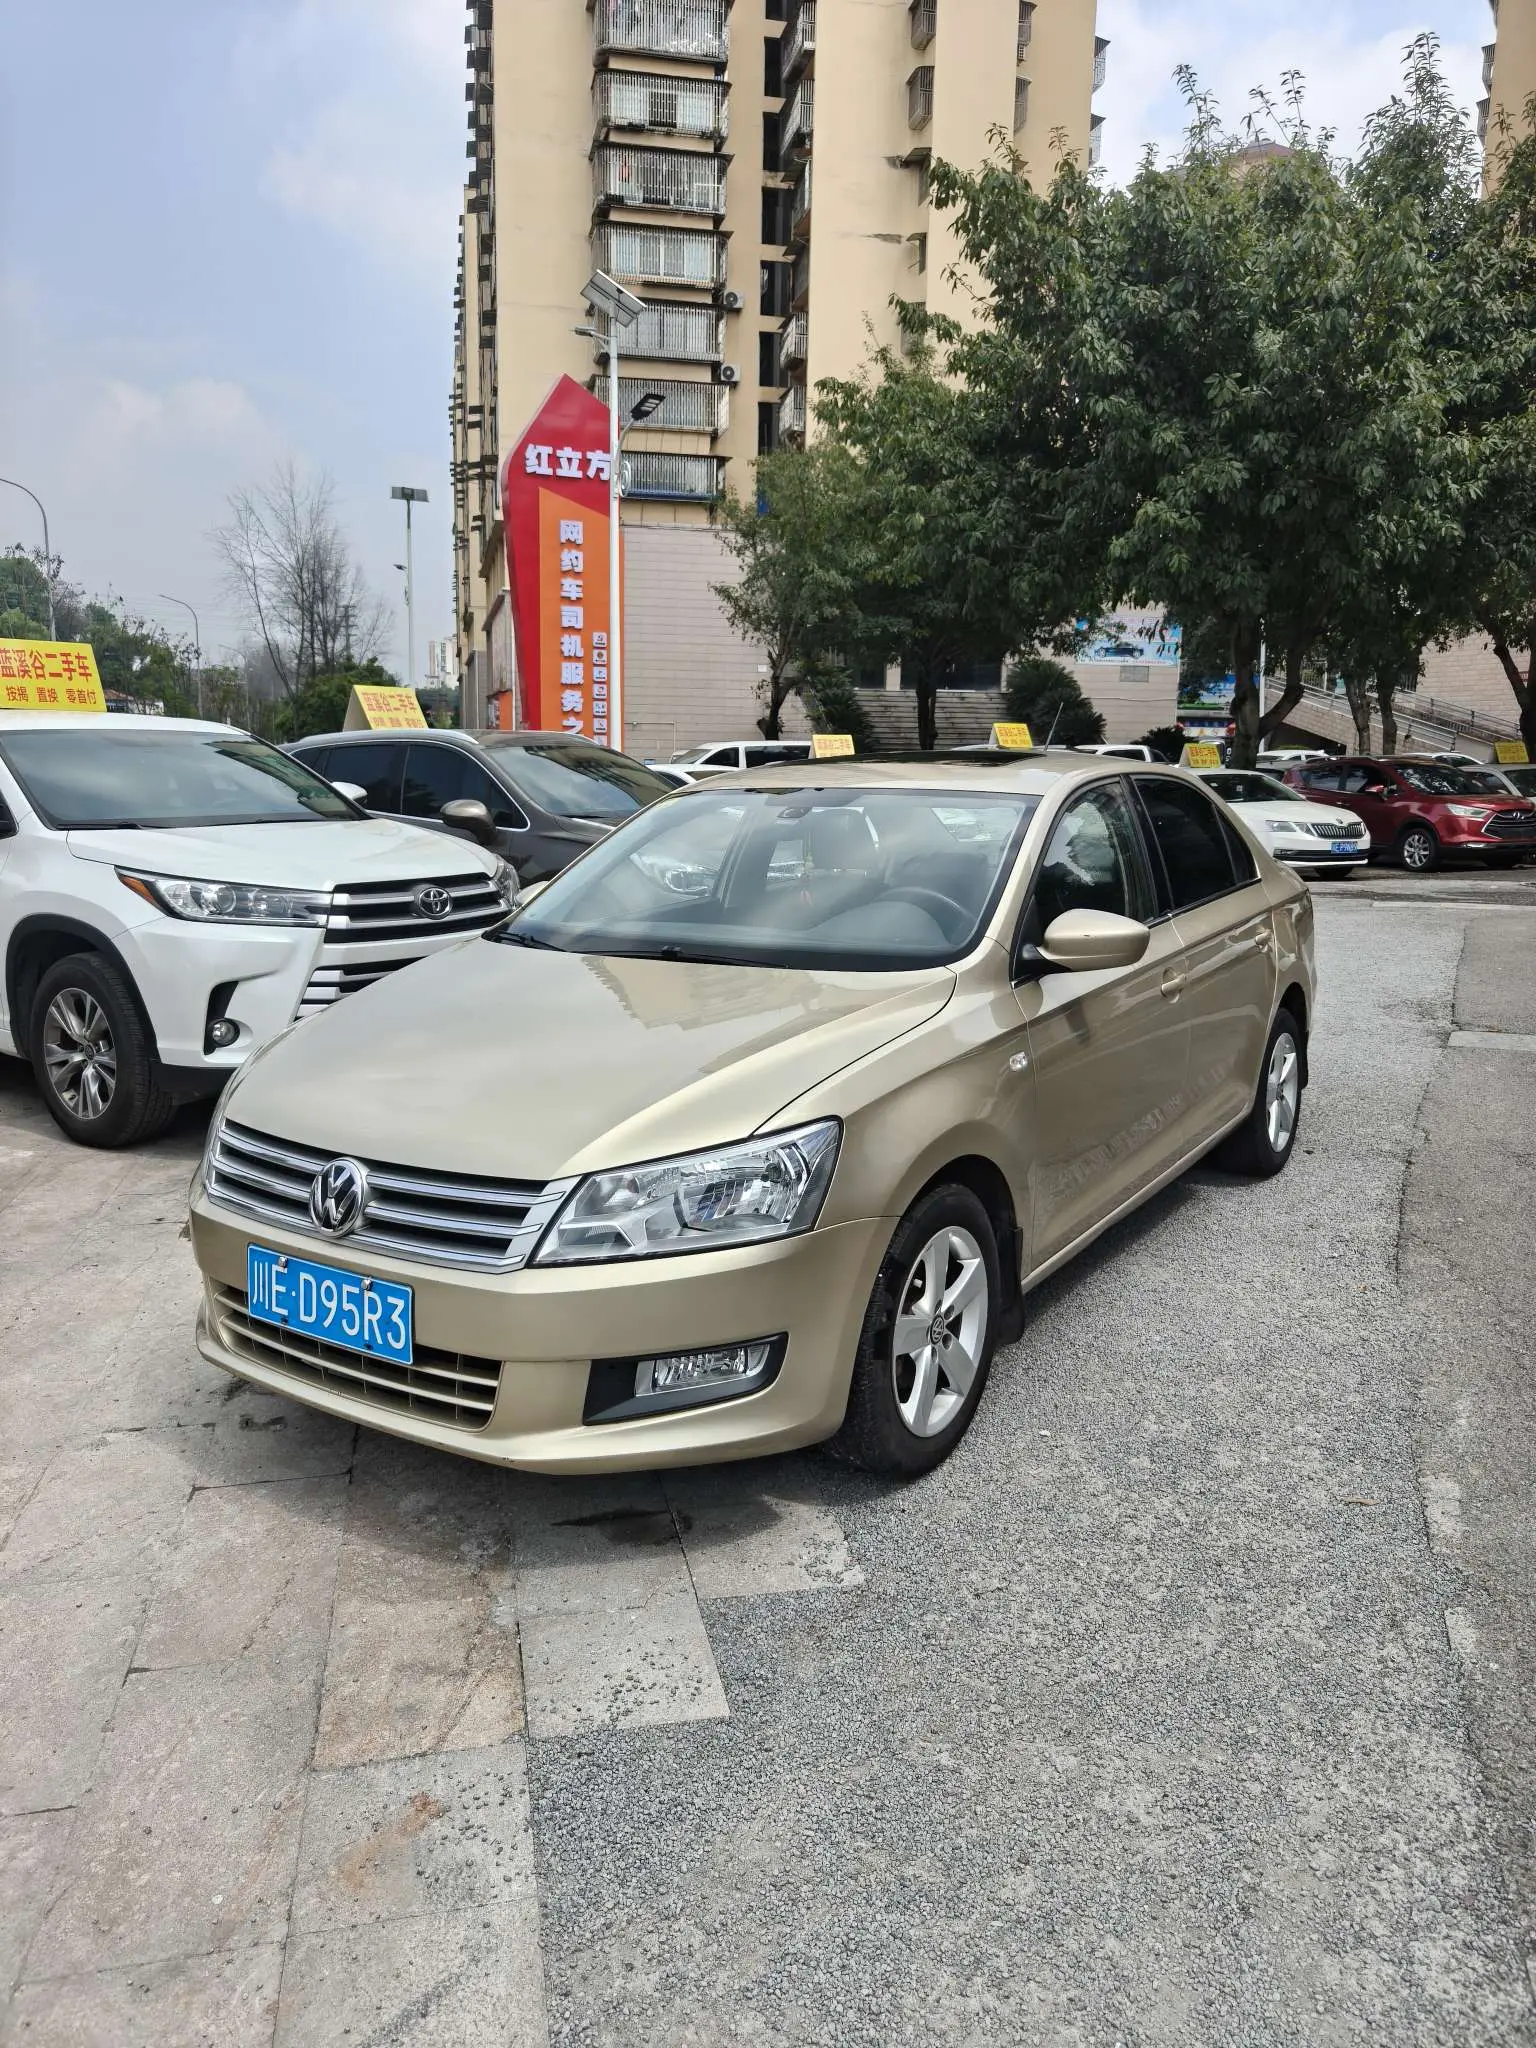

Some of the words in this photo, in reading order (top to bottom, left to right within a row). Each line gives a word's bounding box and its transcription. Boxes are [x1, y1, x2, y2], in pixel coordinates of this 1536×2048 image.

[525, 443, 611, 481] 红立方
[560, 519, 584, 734] 网约车司机服务之
[0, 648, 92, 683] 蓝溪谷二手车
[6, 685, 28, 702] 按揭
[36, 686, 59, 703] 置换
[66, 688, 96, 704] 零首付
